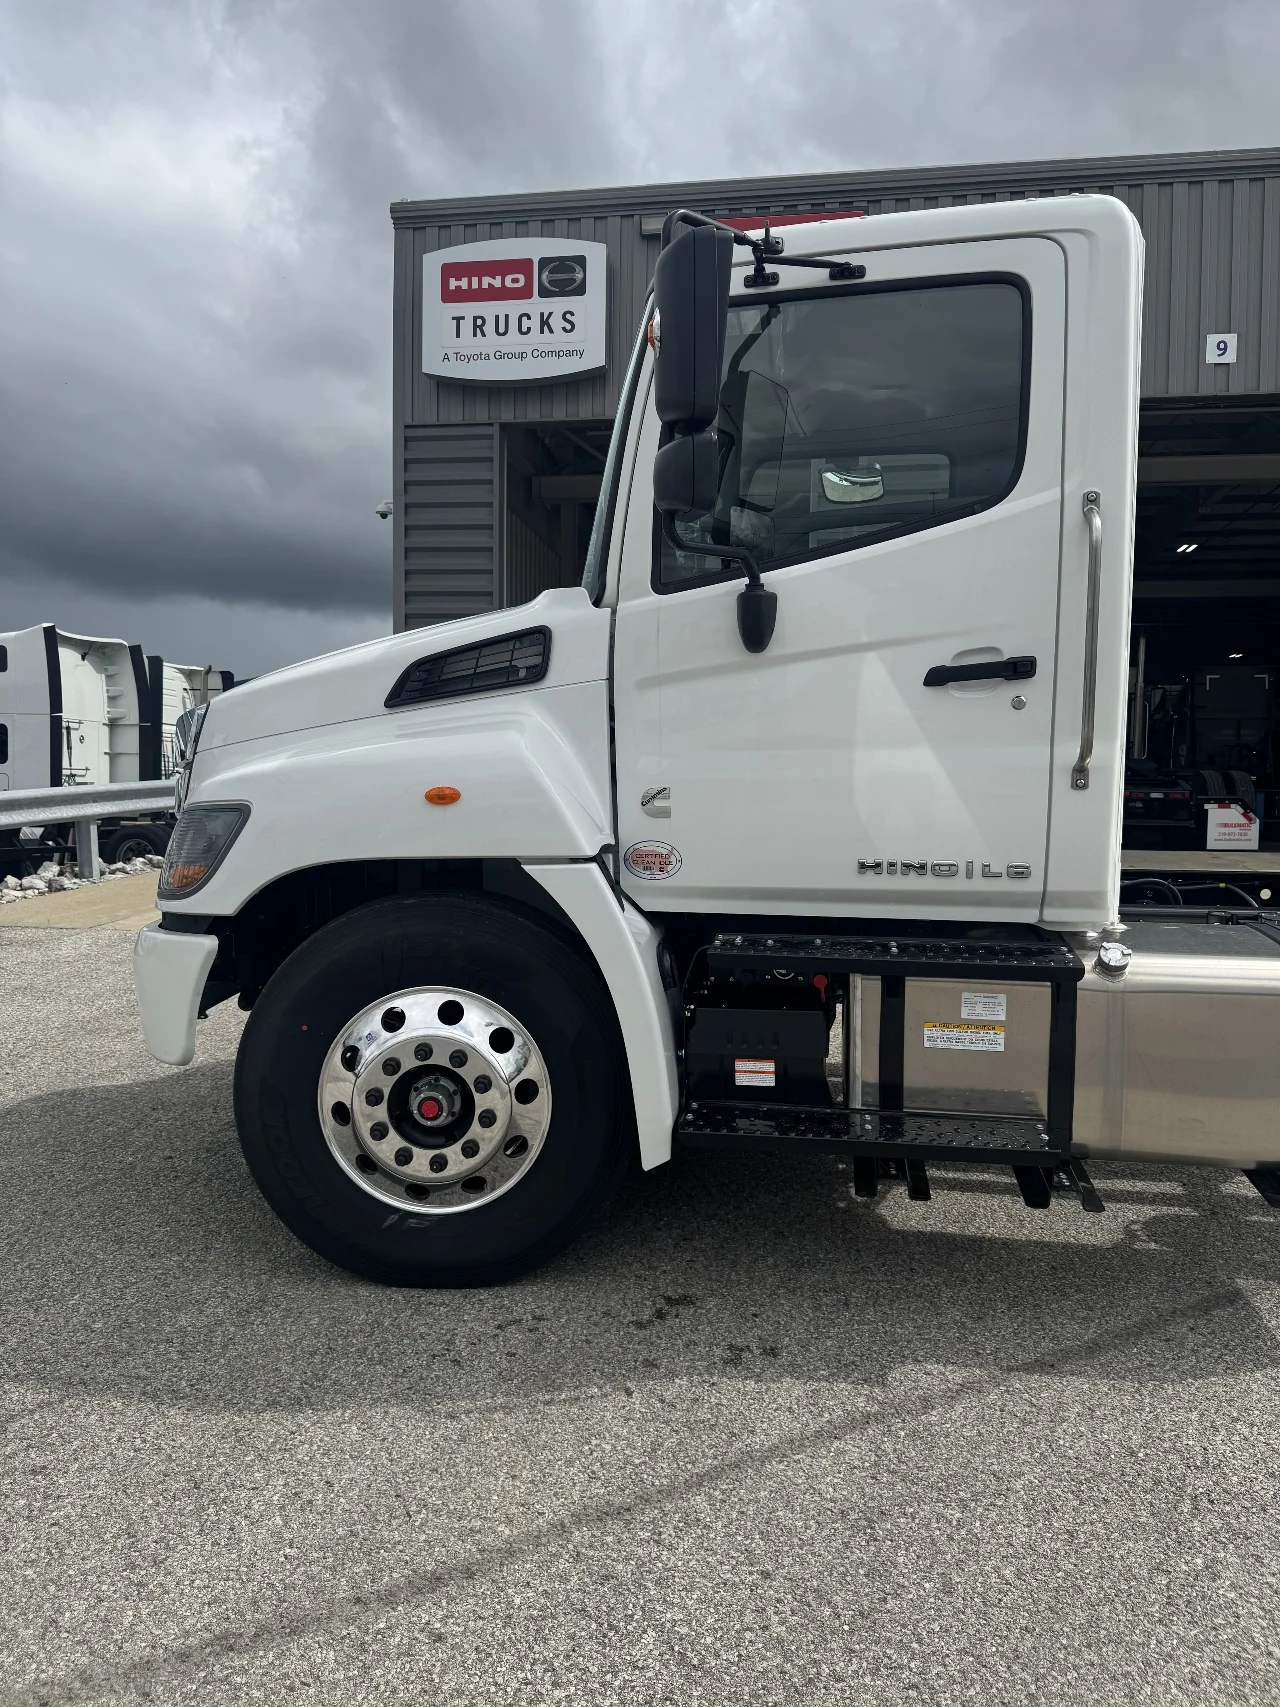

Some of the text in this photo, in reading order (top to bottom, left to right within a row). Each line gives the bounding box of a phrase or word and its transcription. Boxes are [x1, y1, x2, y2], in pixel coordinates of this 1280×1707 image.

[449, 273, 526, 290] HINO
[451, 310, 576, 339] TRUCKS
[442, 348, 585, 364] A Toyota Group Company
[1216, 340, 1228, 357] 9
[641, 787, 668, 807] Cummins
[857, 859, 1032, 878] HINO L6
